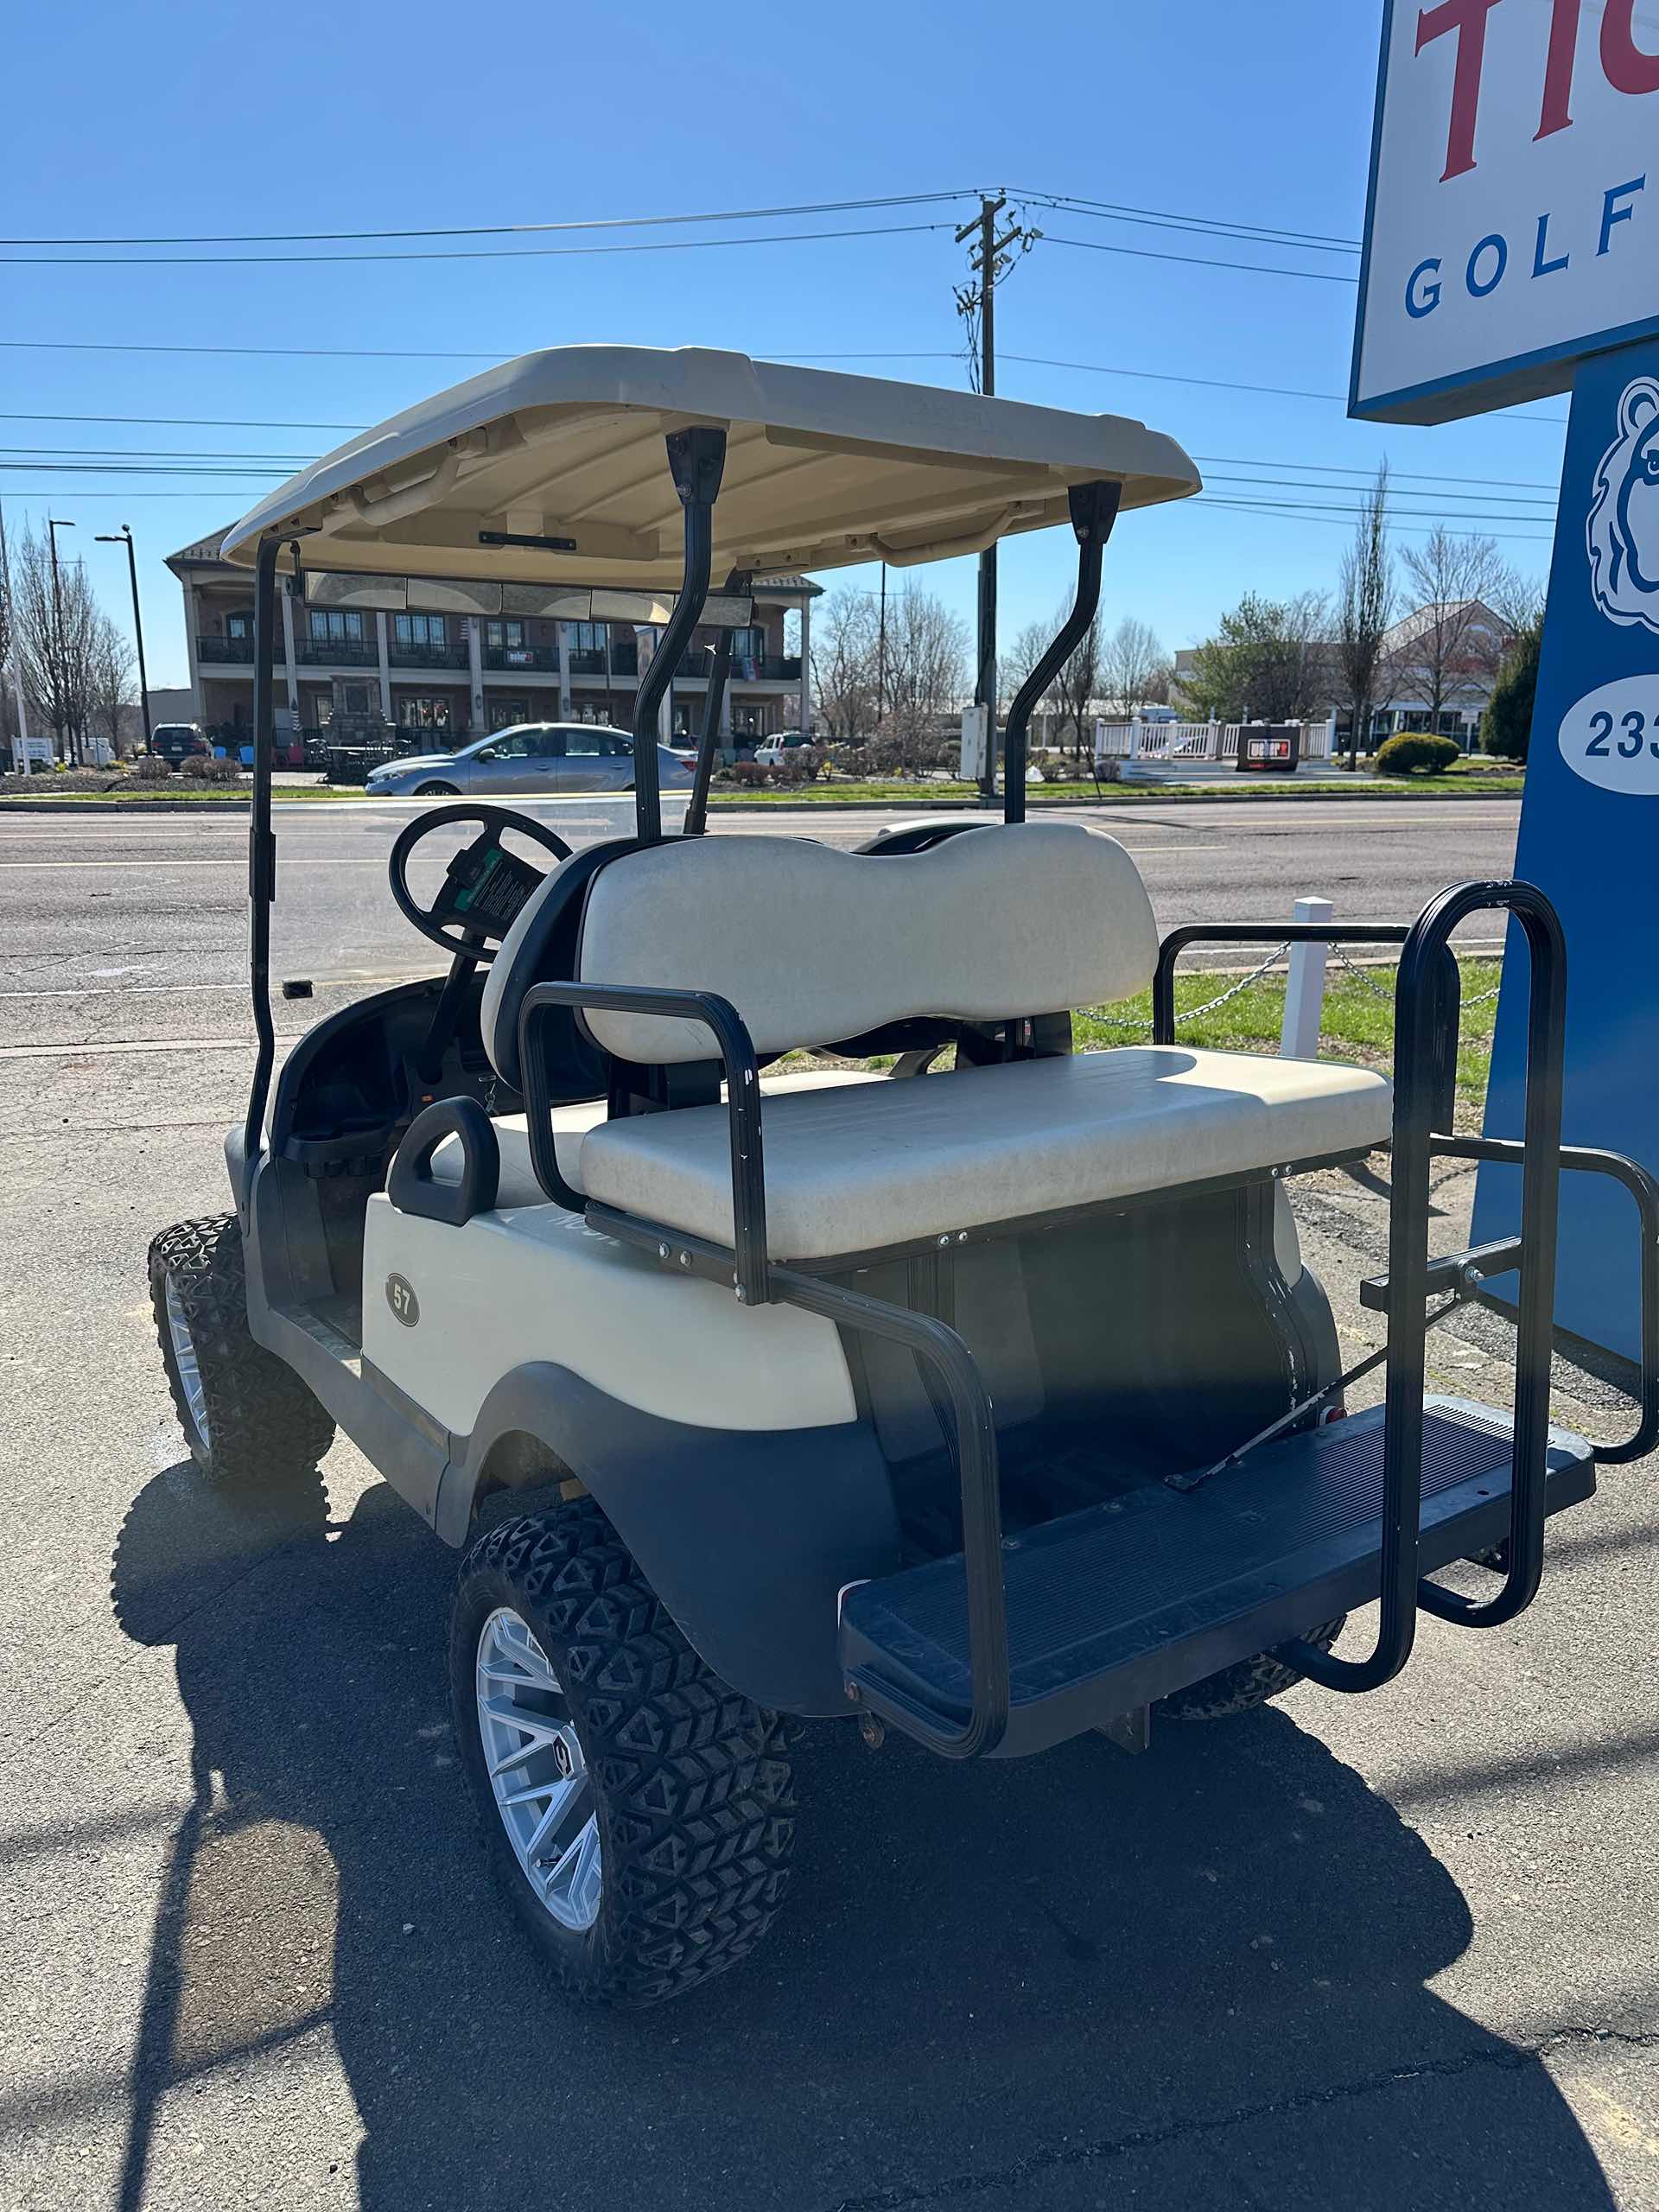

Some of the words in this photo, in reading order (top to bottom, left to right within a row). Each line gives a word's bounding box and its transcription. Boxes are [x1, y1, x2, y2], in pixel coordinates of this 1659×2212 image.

[1414, 0, 1659, 184] TI
[1405, 174, 1646, 319] GOLF
[394, 1283, 410, 1314] 57
